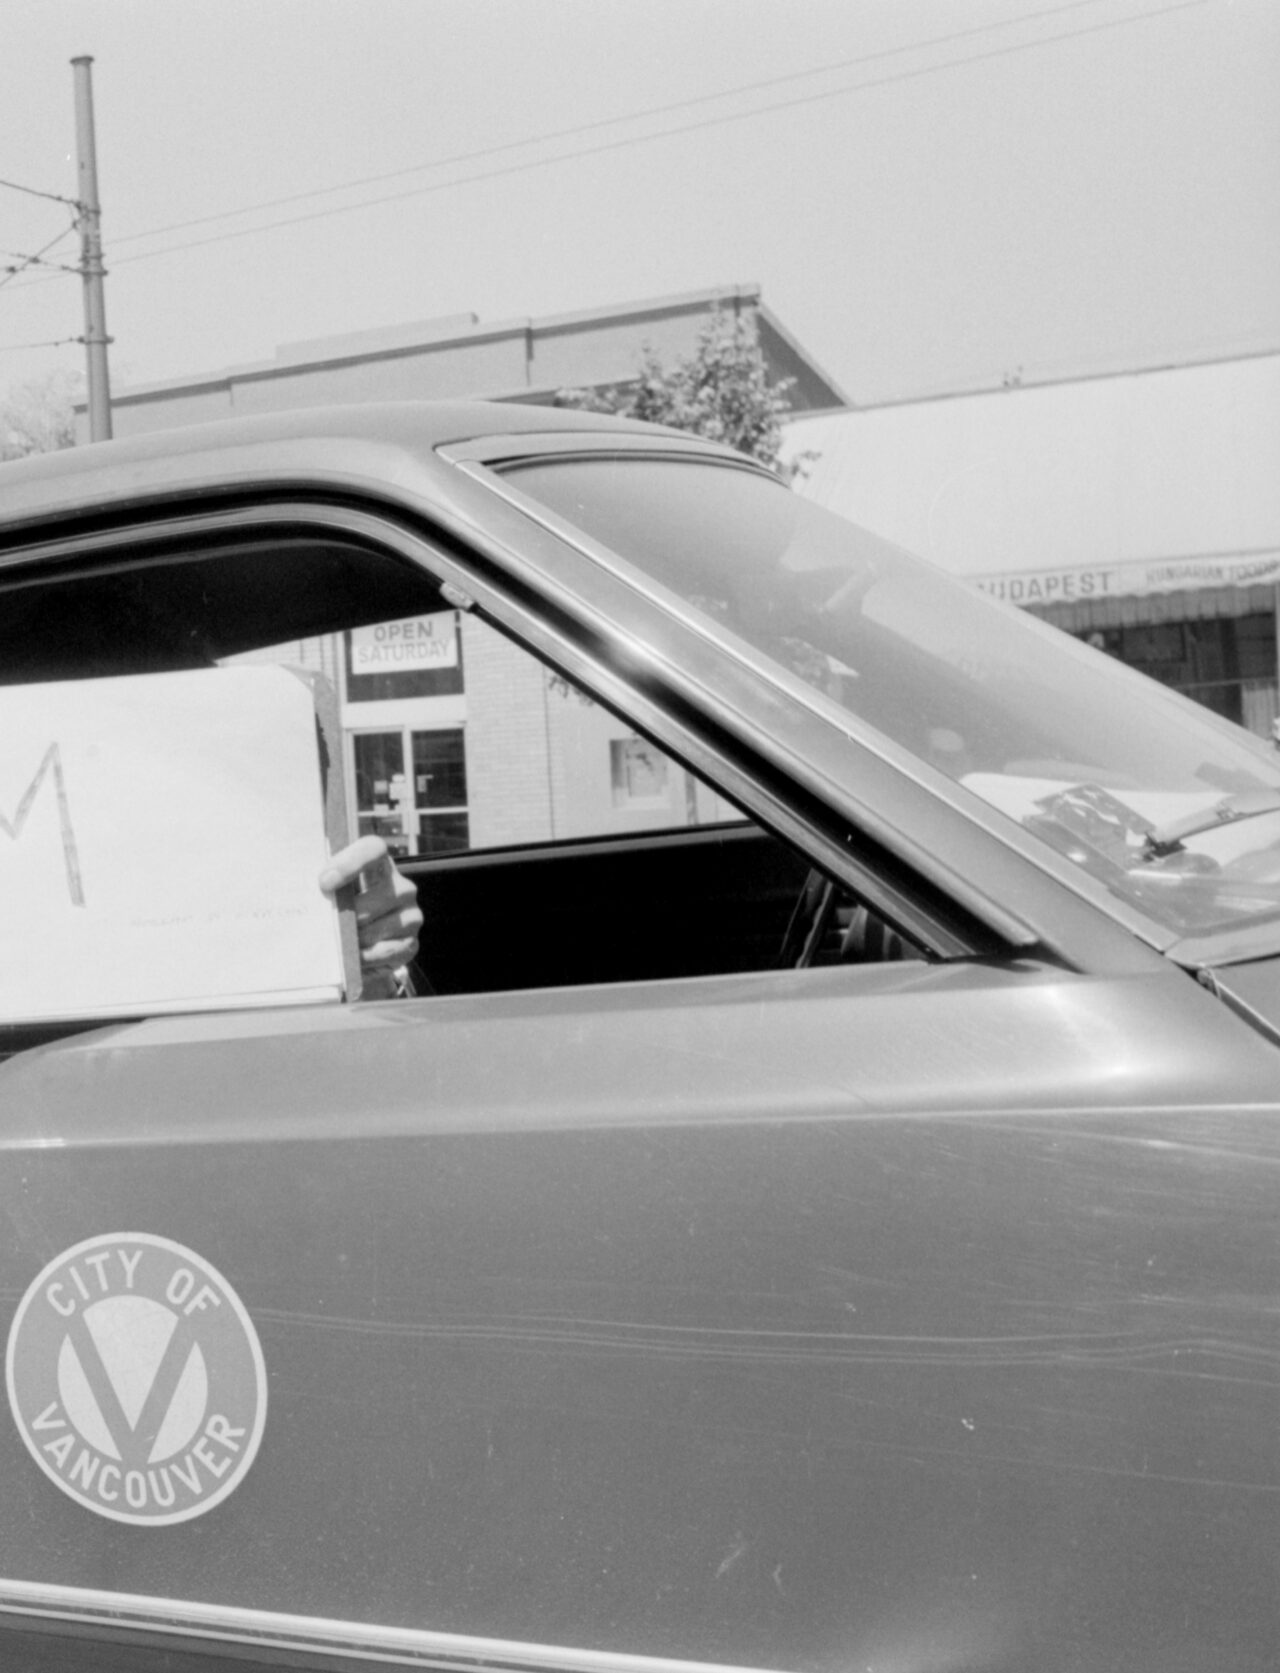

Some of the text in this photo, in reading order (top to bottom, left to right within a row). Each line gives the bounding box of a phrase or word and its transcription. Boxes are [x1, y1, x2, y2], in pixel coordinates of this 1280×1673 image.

[977, 571, 1115, 600] UDAPEST
[373, 621, 434, 642] OPEN
[358, 639, 450, 664] SATURDAY
[46, 1249, 221, 1316] CITY OF
[31, 1401, 246, 1508] VANCOUVER
